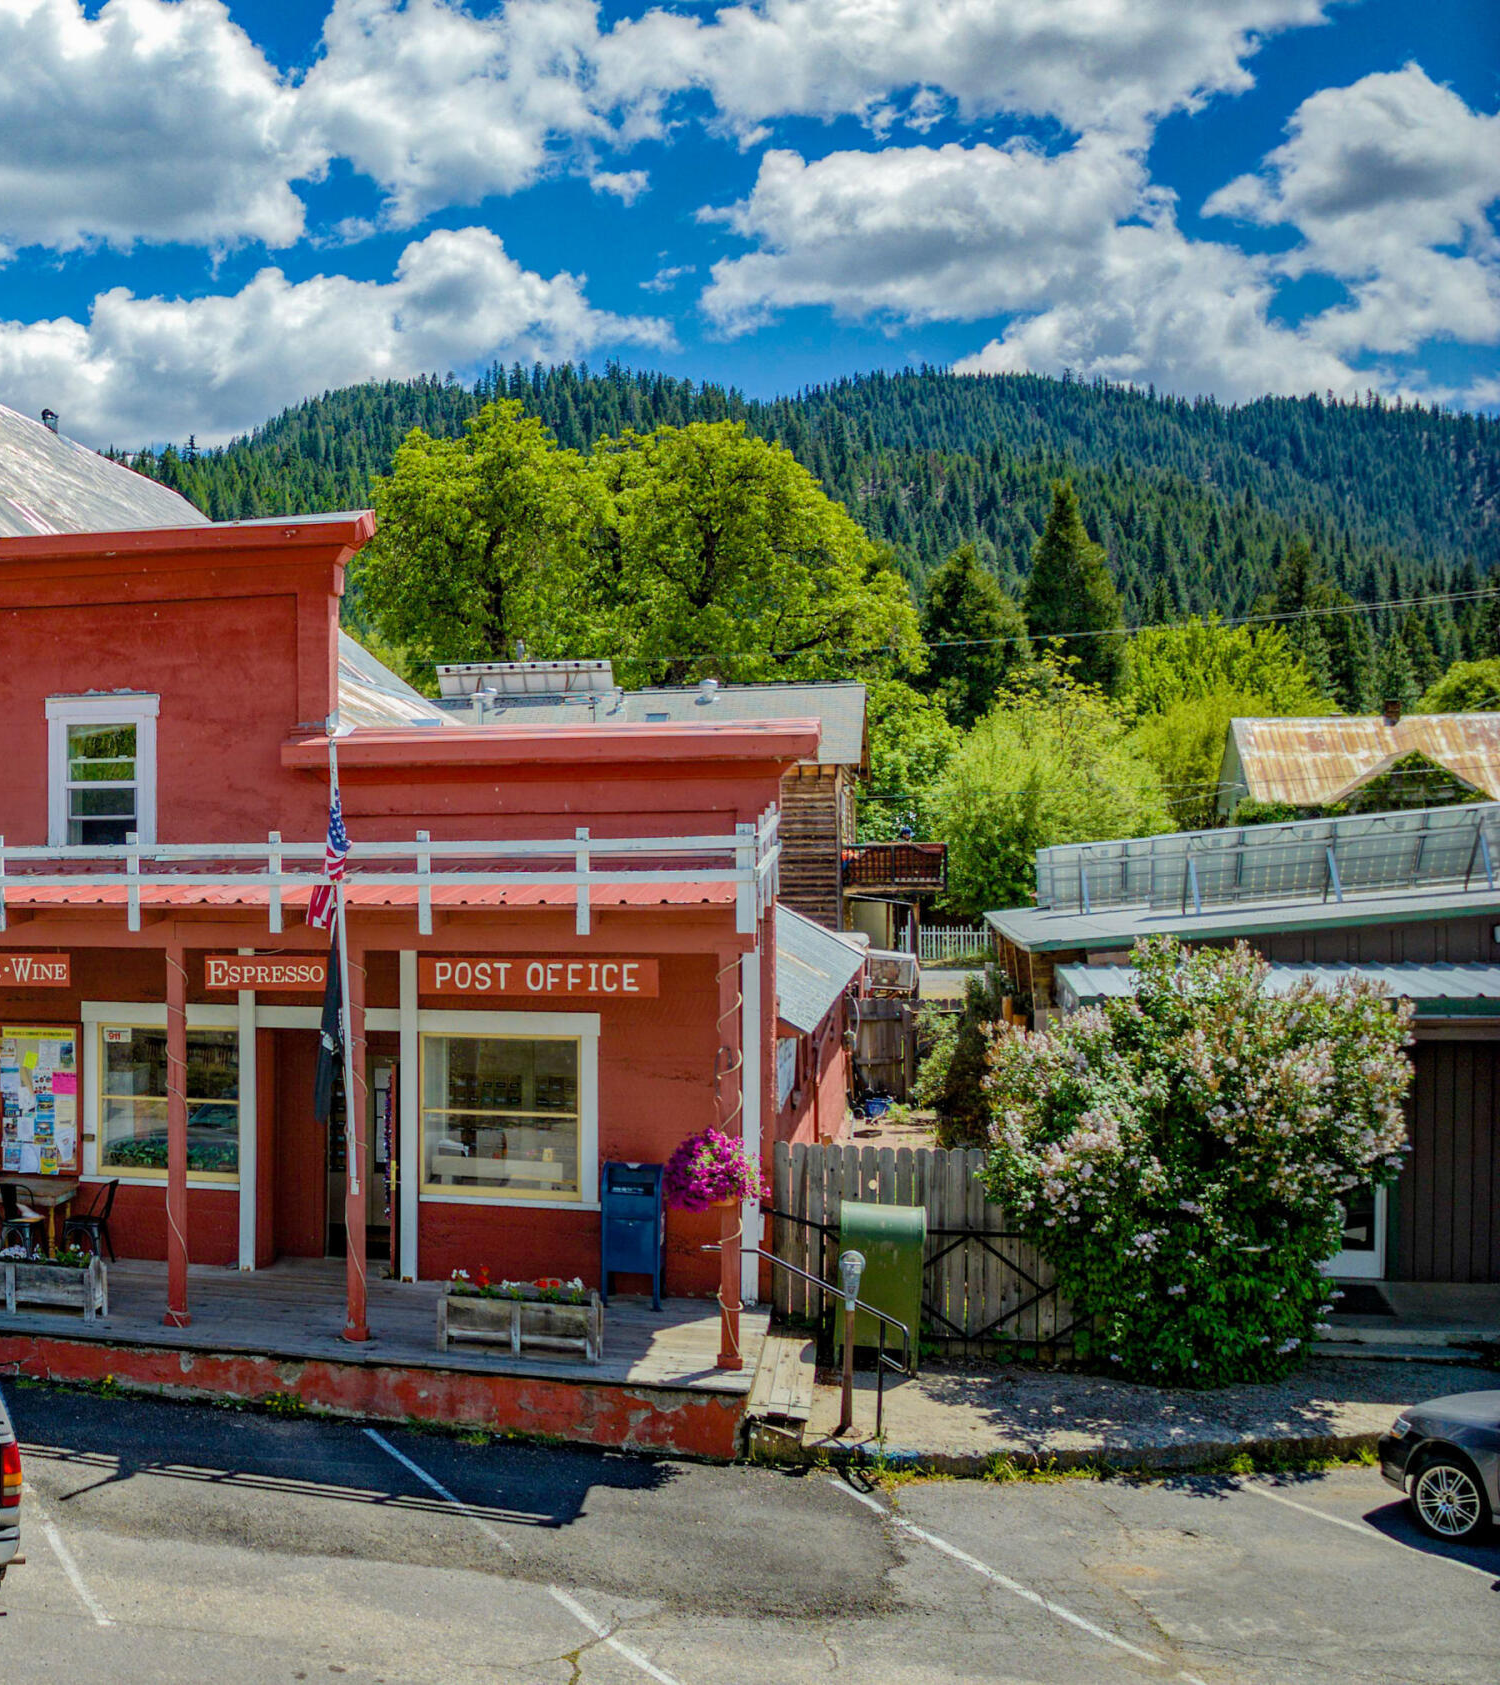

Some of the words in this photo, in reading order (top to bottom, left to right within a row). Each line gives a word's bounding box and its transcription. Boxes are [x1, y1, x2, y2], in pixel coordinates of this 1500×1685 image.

[206, 960, 325, 986] ESPRESSO
[435, 962, 513, 990] POST
[526, 962, 640, 992] OFFICE
